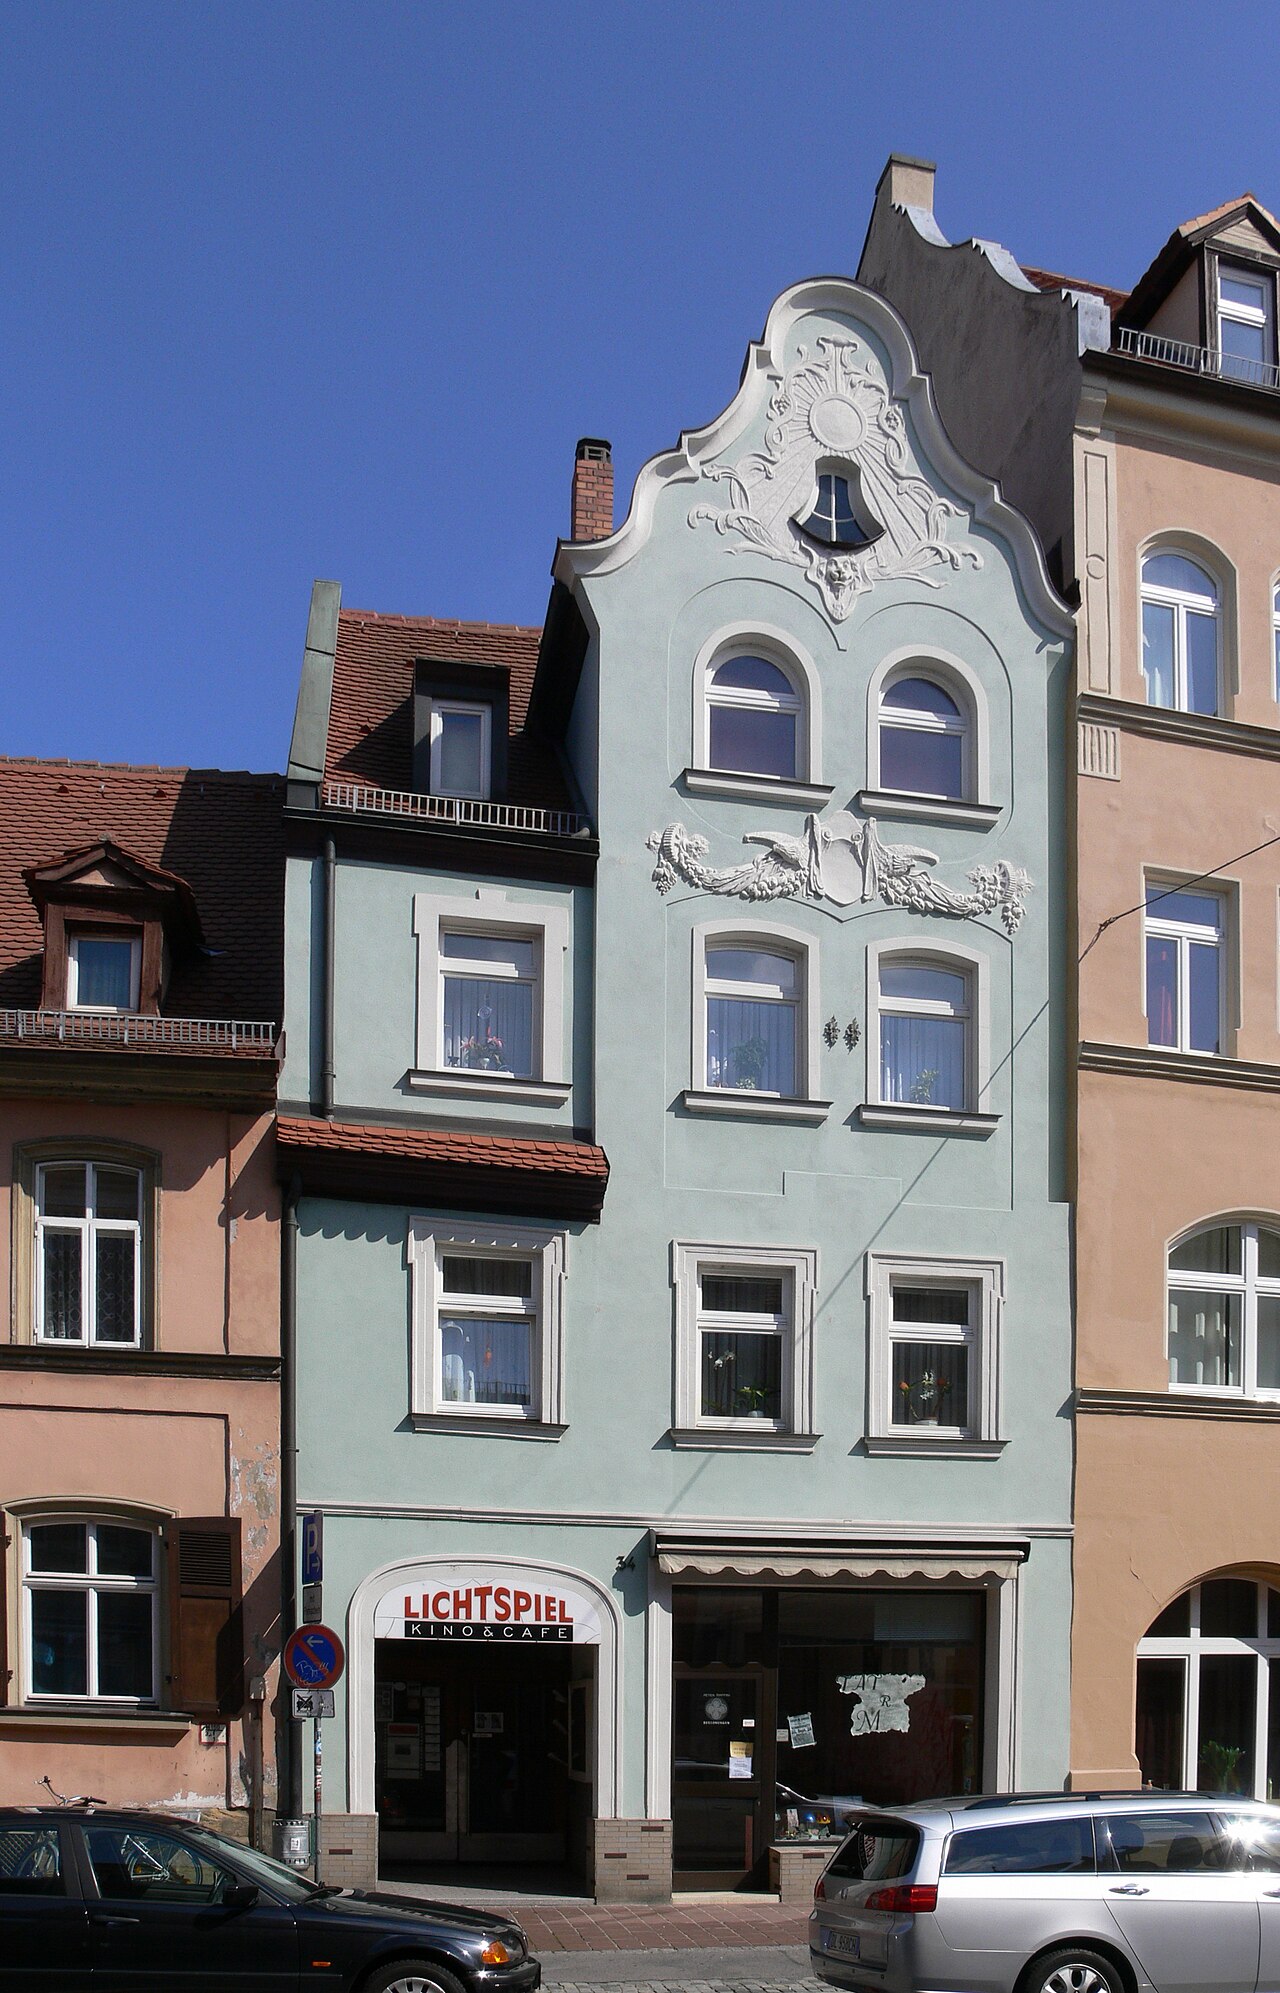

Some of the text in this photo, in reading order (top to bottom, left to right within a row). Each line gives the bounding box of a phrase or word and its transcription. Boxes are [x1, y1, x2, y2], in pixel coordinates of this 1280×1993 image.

[306, 1523, 318, 1574] P
[615, 1555, 636, 1572] 34
[404, 1586, 574, 1623] LICHTSPIEL
[879, 1694, 891, 1708] R
[855, 1709, 881, 1731] M
